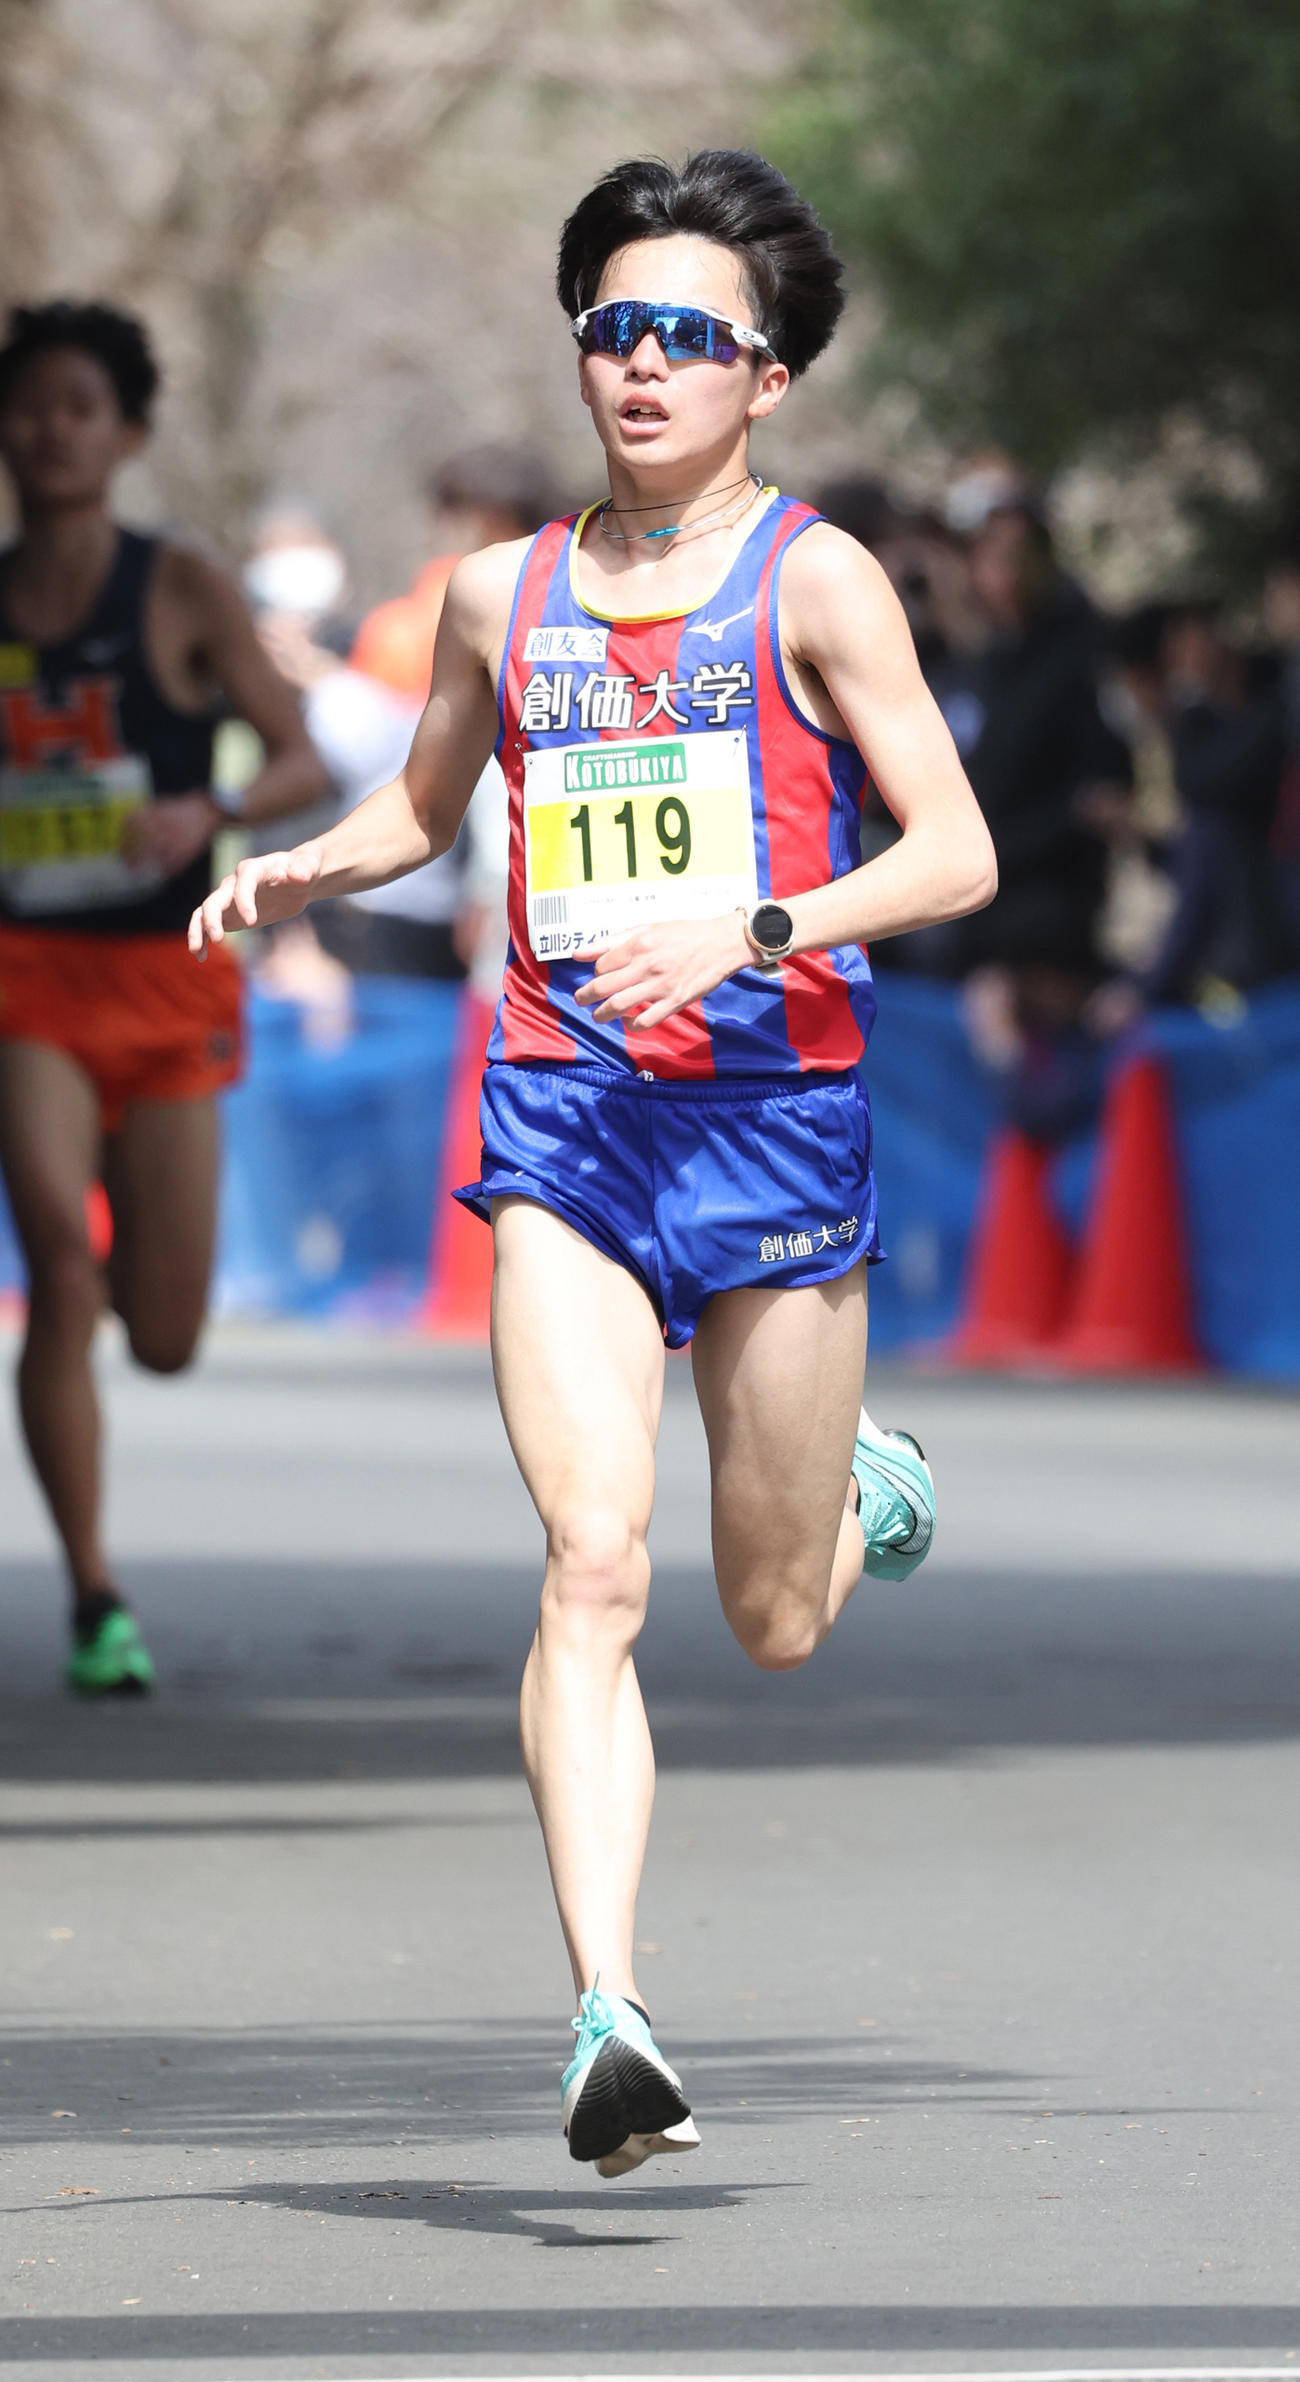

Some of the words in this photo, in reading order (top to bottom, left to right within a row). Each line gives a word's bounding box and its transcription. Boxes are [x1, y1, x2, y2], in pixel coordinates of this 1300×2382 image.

[519, 662, 753, 731] 創価大学
[566, 755, 684, 789] KOTOBUKIYA
[570, 797, 691, 882] 119
[758, 1215, 860, 1263] 創価大学
